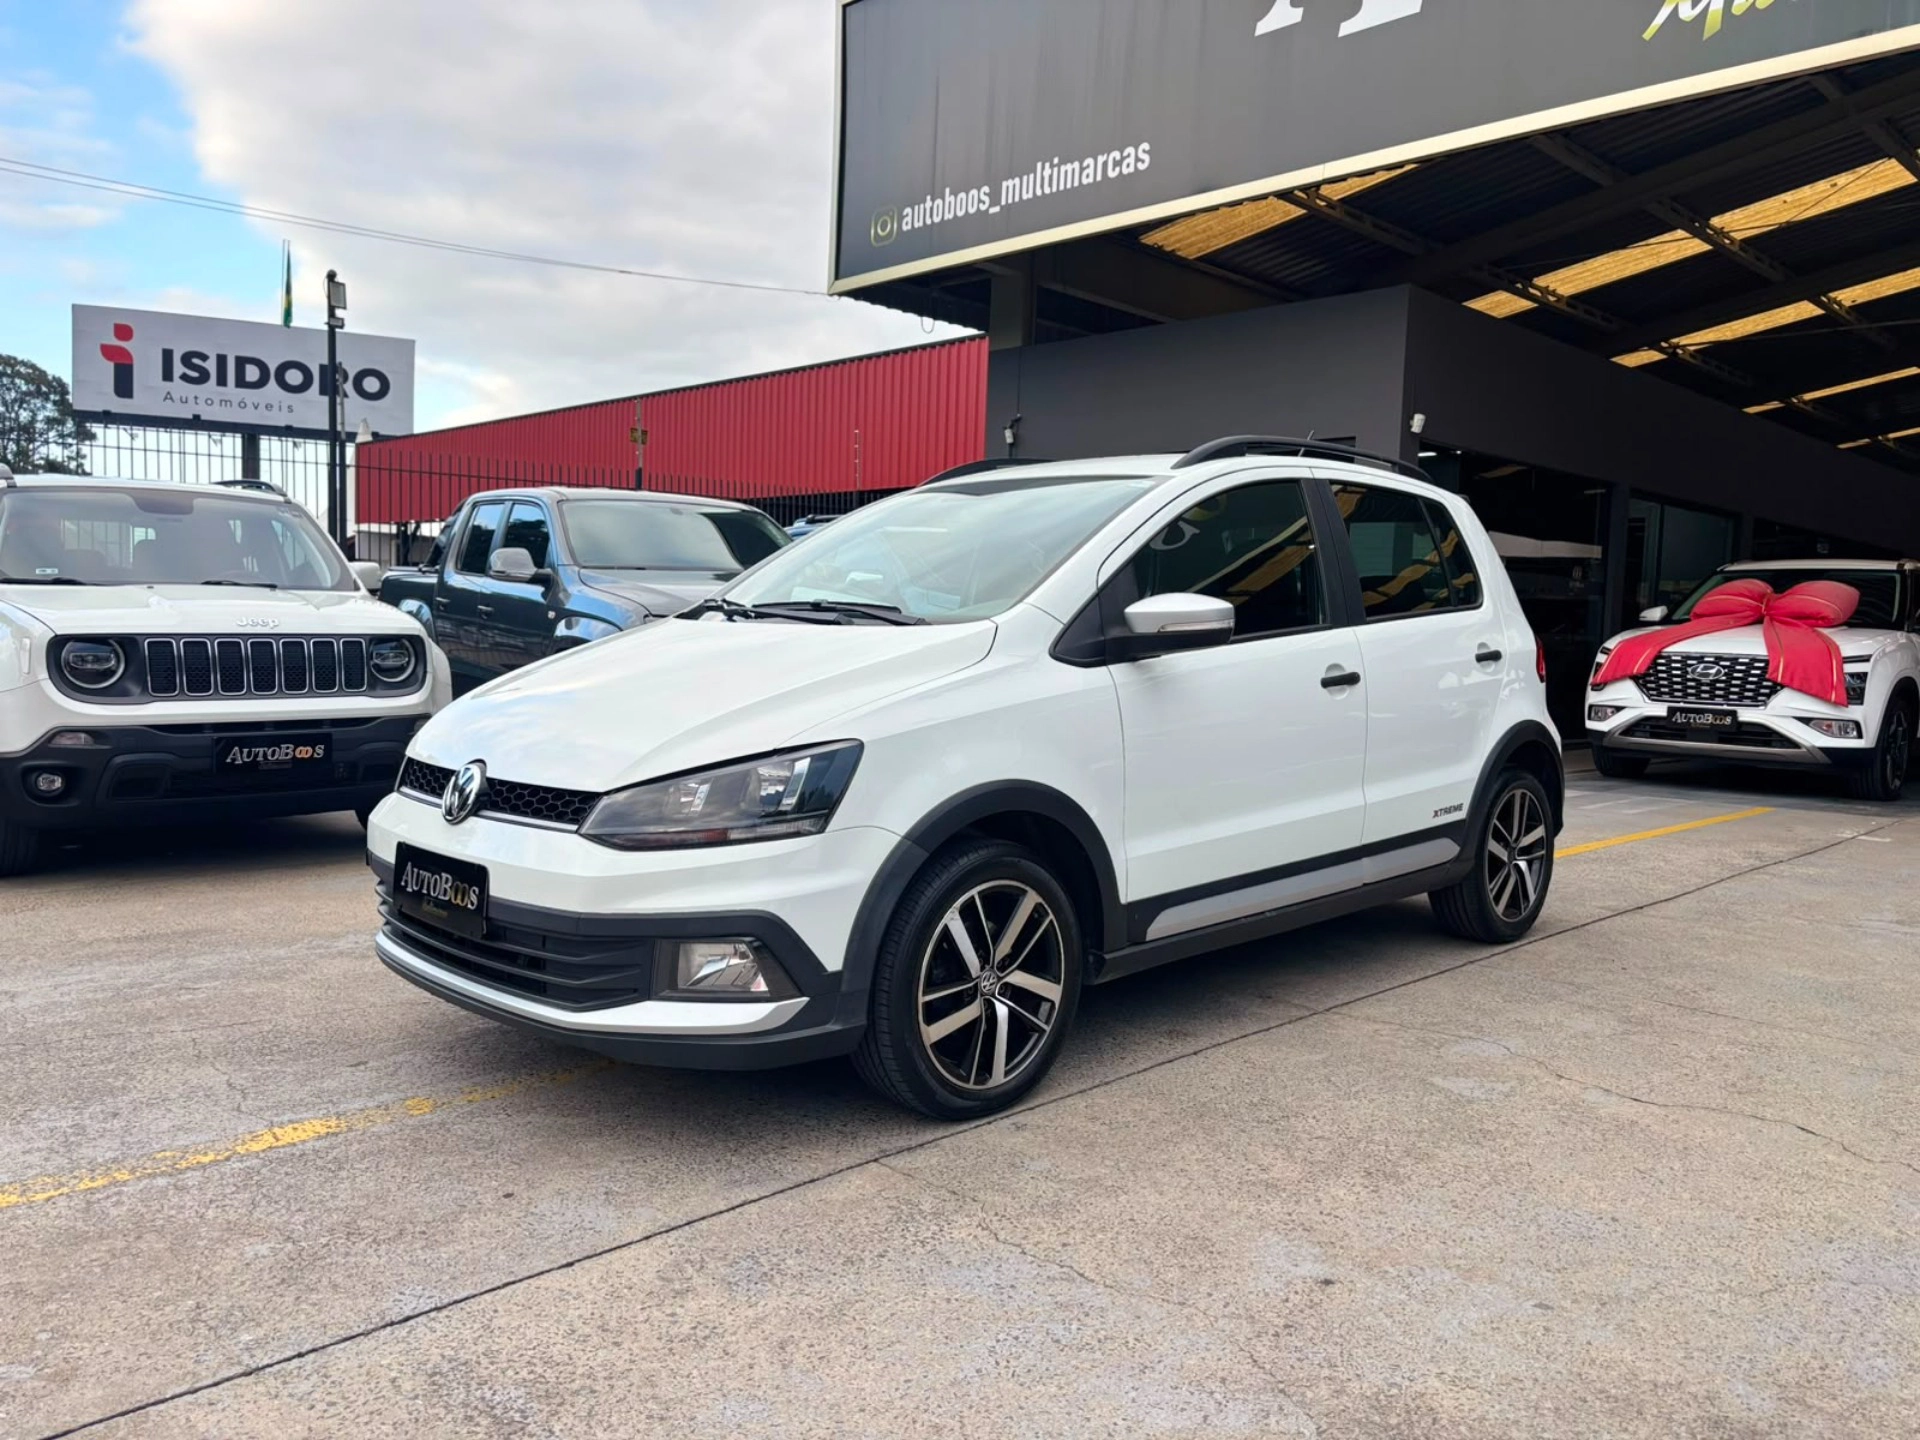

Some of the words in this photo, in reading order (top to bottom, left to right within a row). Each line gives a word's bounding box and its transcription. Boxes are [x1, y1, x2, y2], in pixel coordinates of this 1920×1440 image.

[902, 142, 1151, 231] autoboos_multimarcas
[161, 347, 391, 401] ISIDORO
[163, 390, 295, 414] Automóveis
[236, 616, 279, 629] Jeep
[1432, 803, 1464, 819] XTREME
